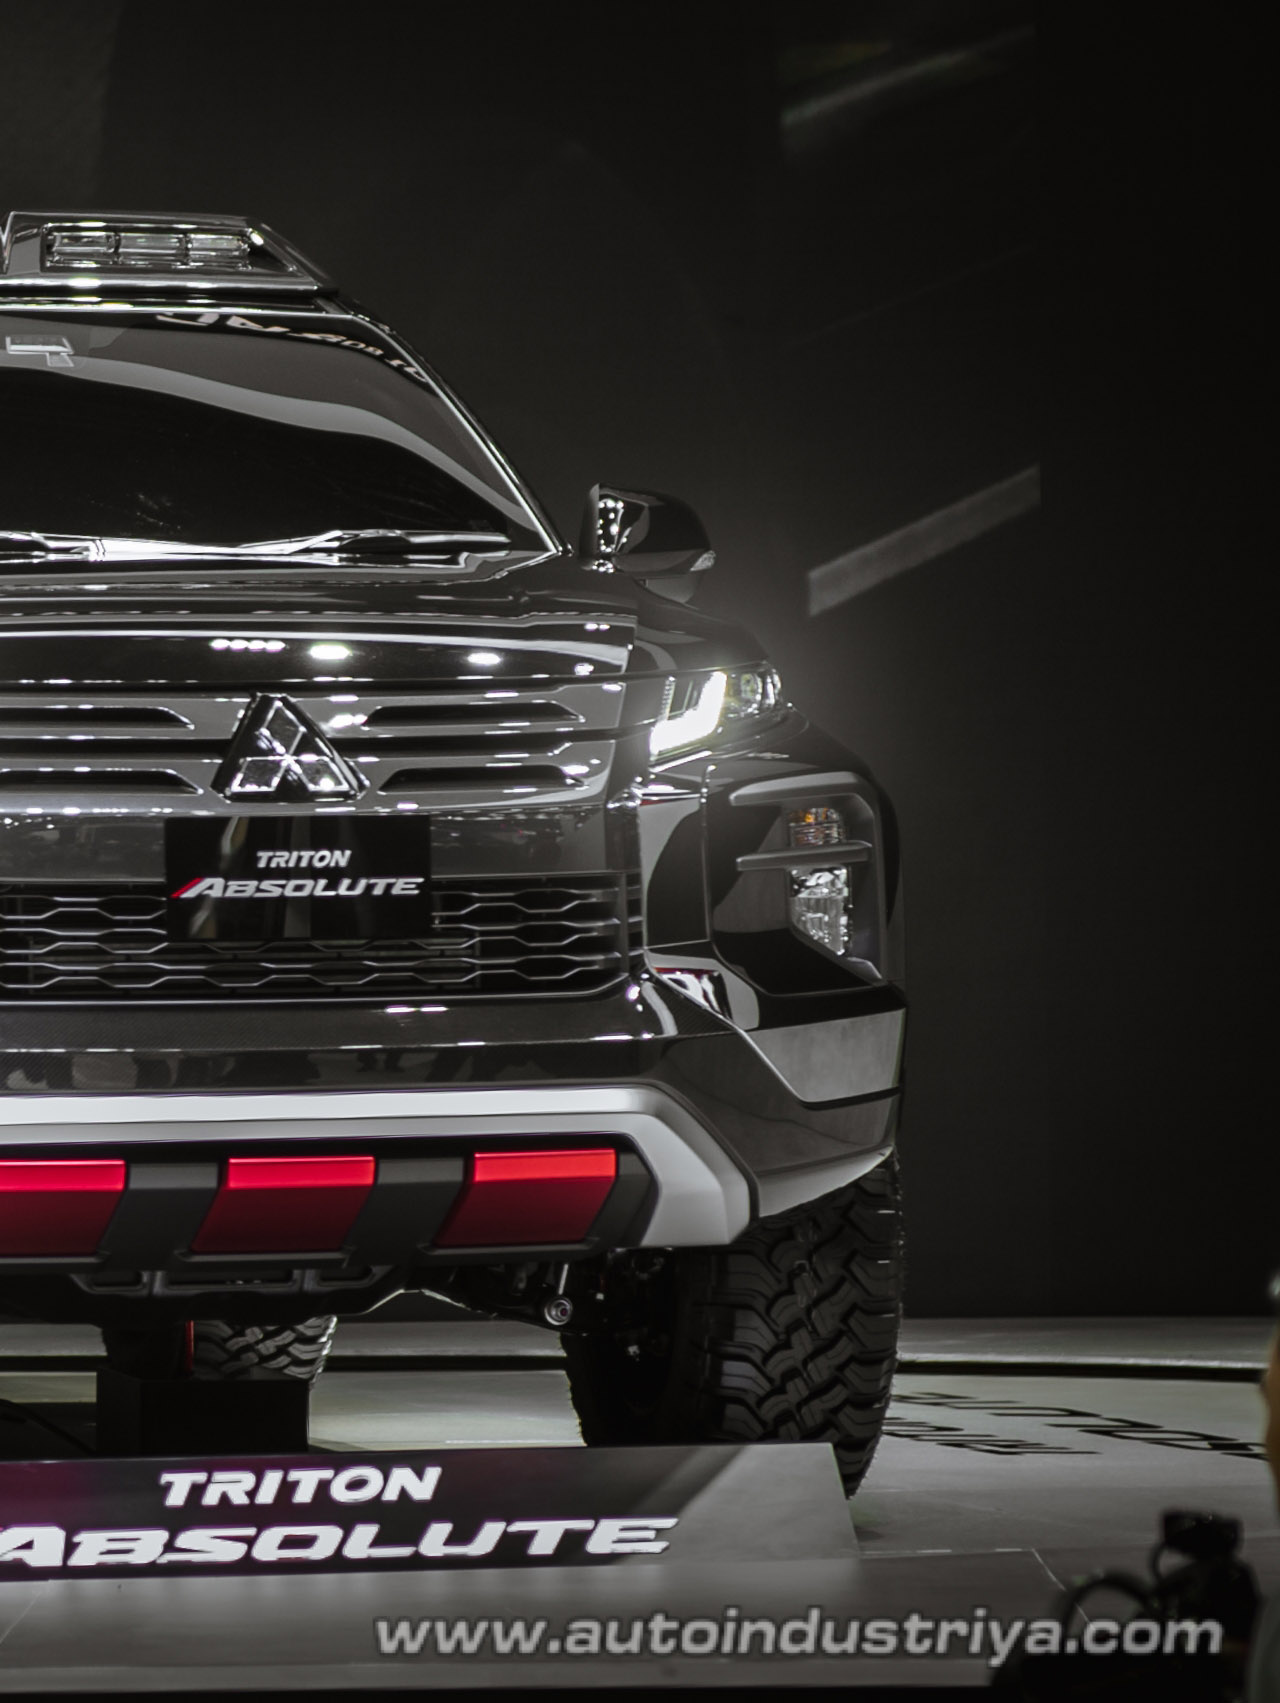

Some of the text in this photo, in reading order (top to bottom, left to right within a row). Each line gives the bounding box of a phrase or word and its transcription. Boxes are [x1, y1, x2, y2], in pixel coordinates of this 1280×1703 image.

[256, 850, 352, 868] TRITON
[171, 877, 425, 898] ABSOLUTE
[160, 1466, 442, 1506] TRITON
